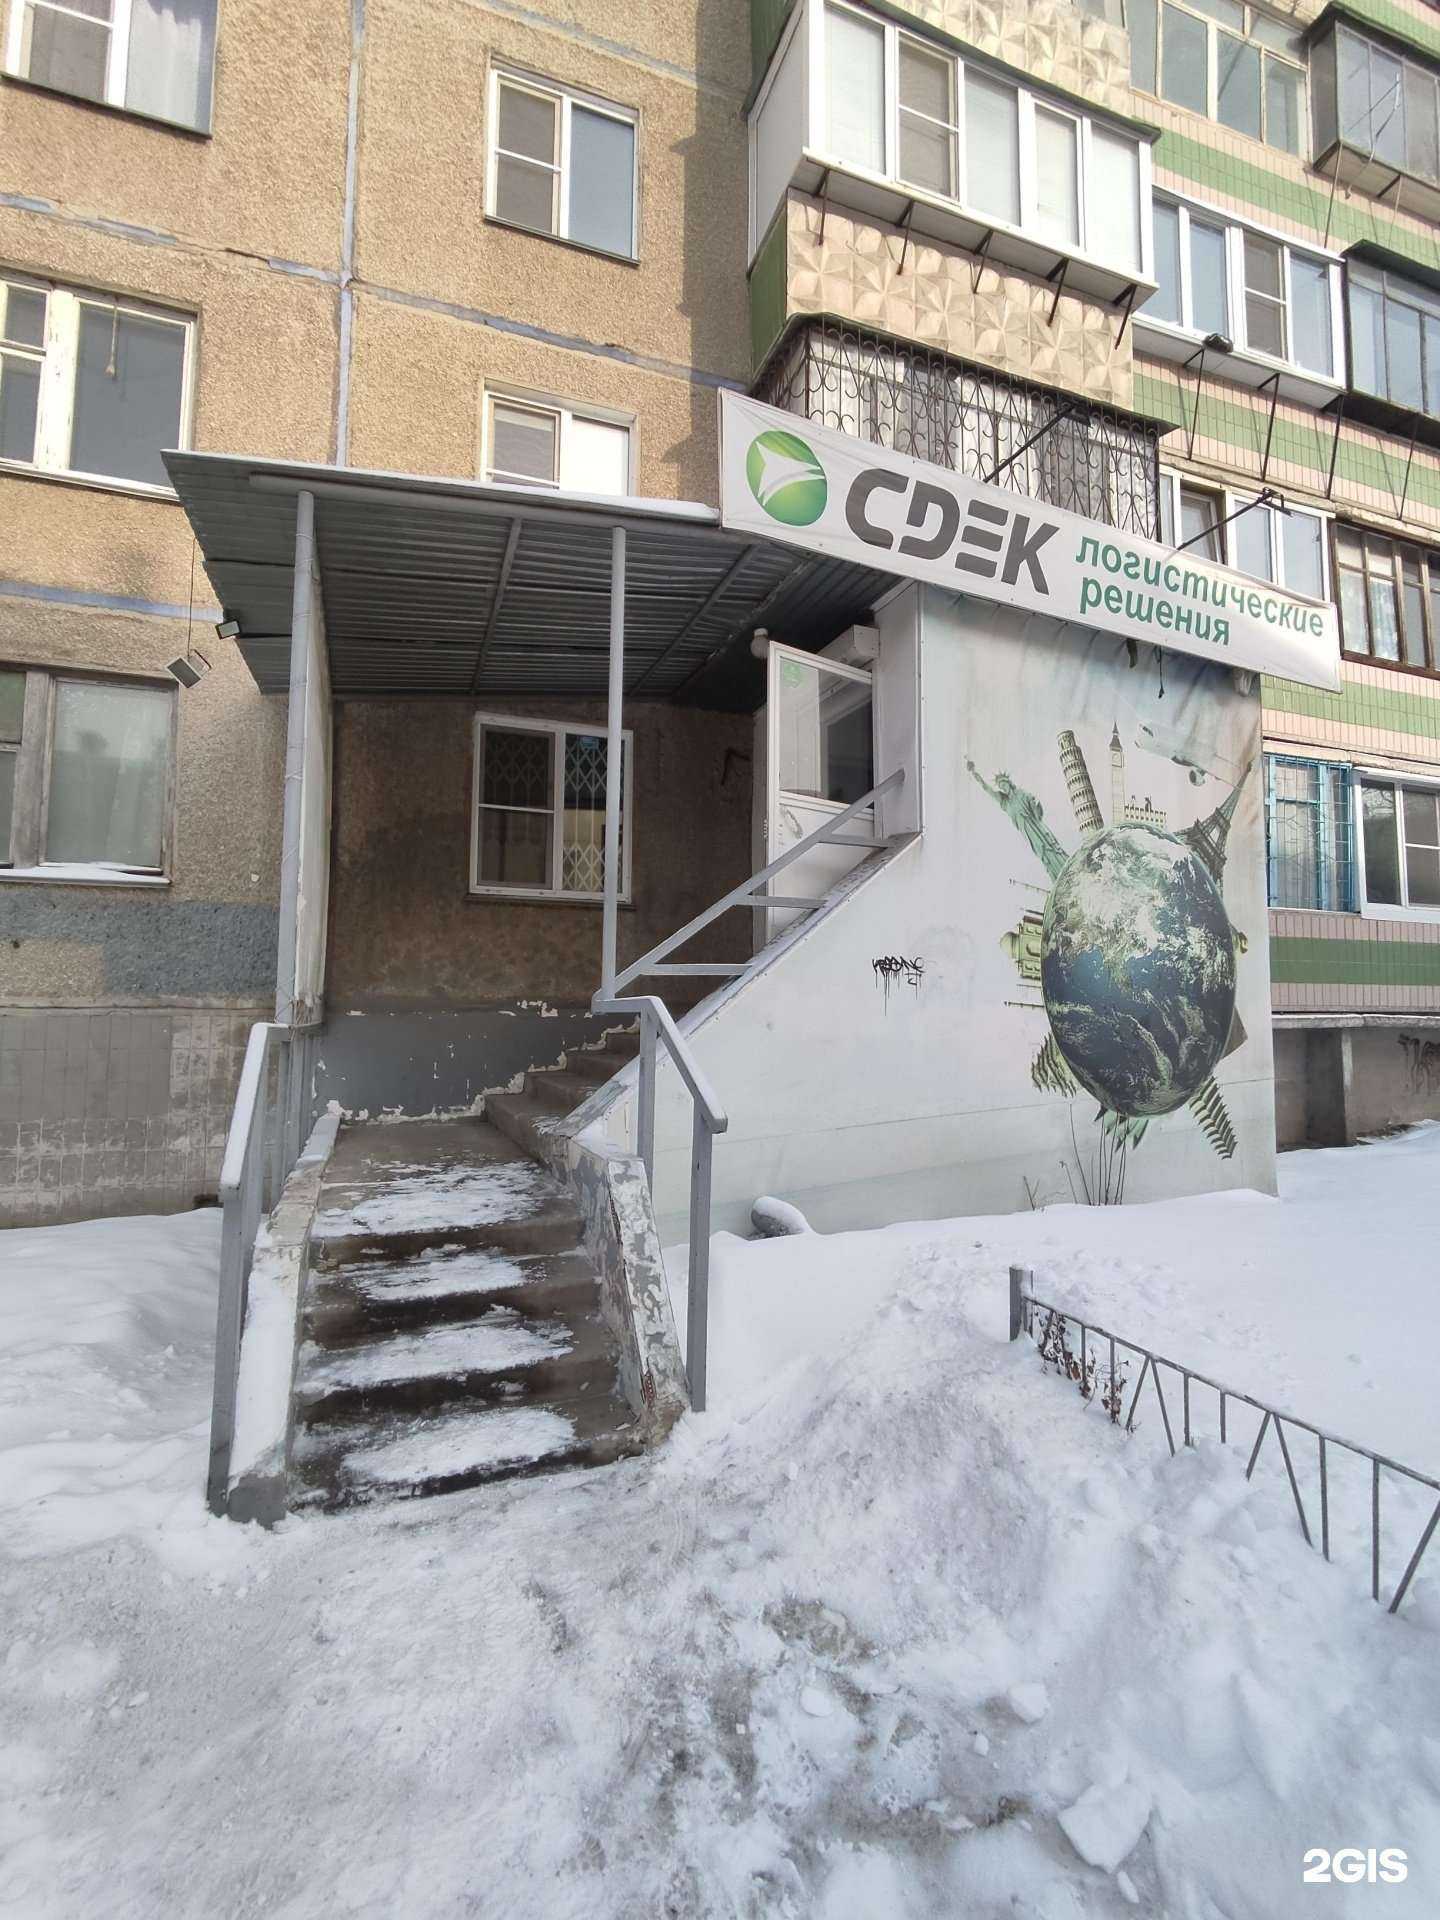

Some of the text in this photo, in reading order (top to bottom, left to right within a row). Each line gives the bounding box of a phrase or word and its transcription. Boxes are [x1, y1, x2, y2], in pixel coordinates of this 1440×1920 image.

[845, 468, 1060, 596] CDEK
[1075, 537, 1324, 637] логистические
[1080, 577, 1230, 646] решения
